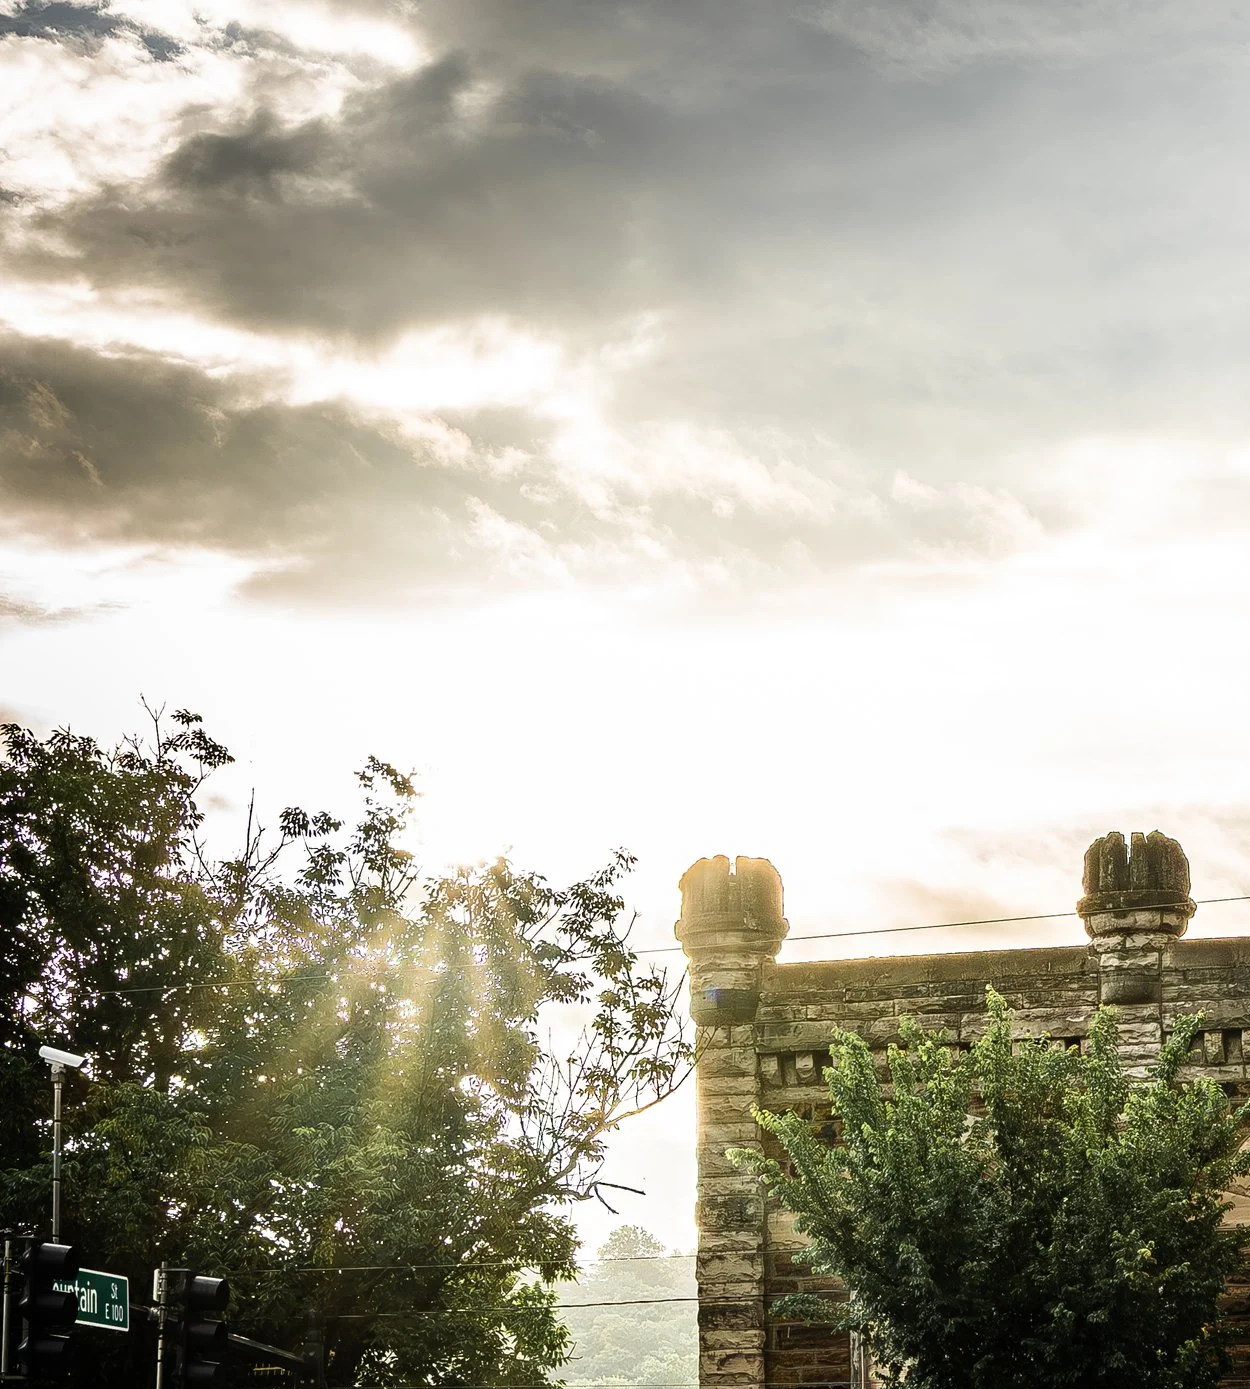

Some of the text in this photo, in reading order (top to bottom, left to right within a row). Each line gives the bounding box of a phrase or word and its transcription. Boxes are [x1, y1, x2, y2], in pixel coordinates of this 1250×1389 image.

[52, 1280, 119, 1314] tain St
[105, 1303, 124, 1322] E 100
